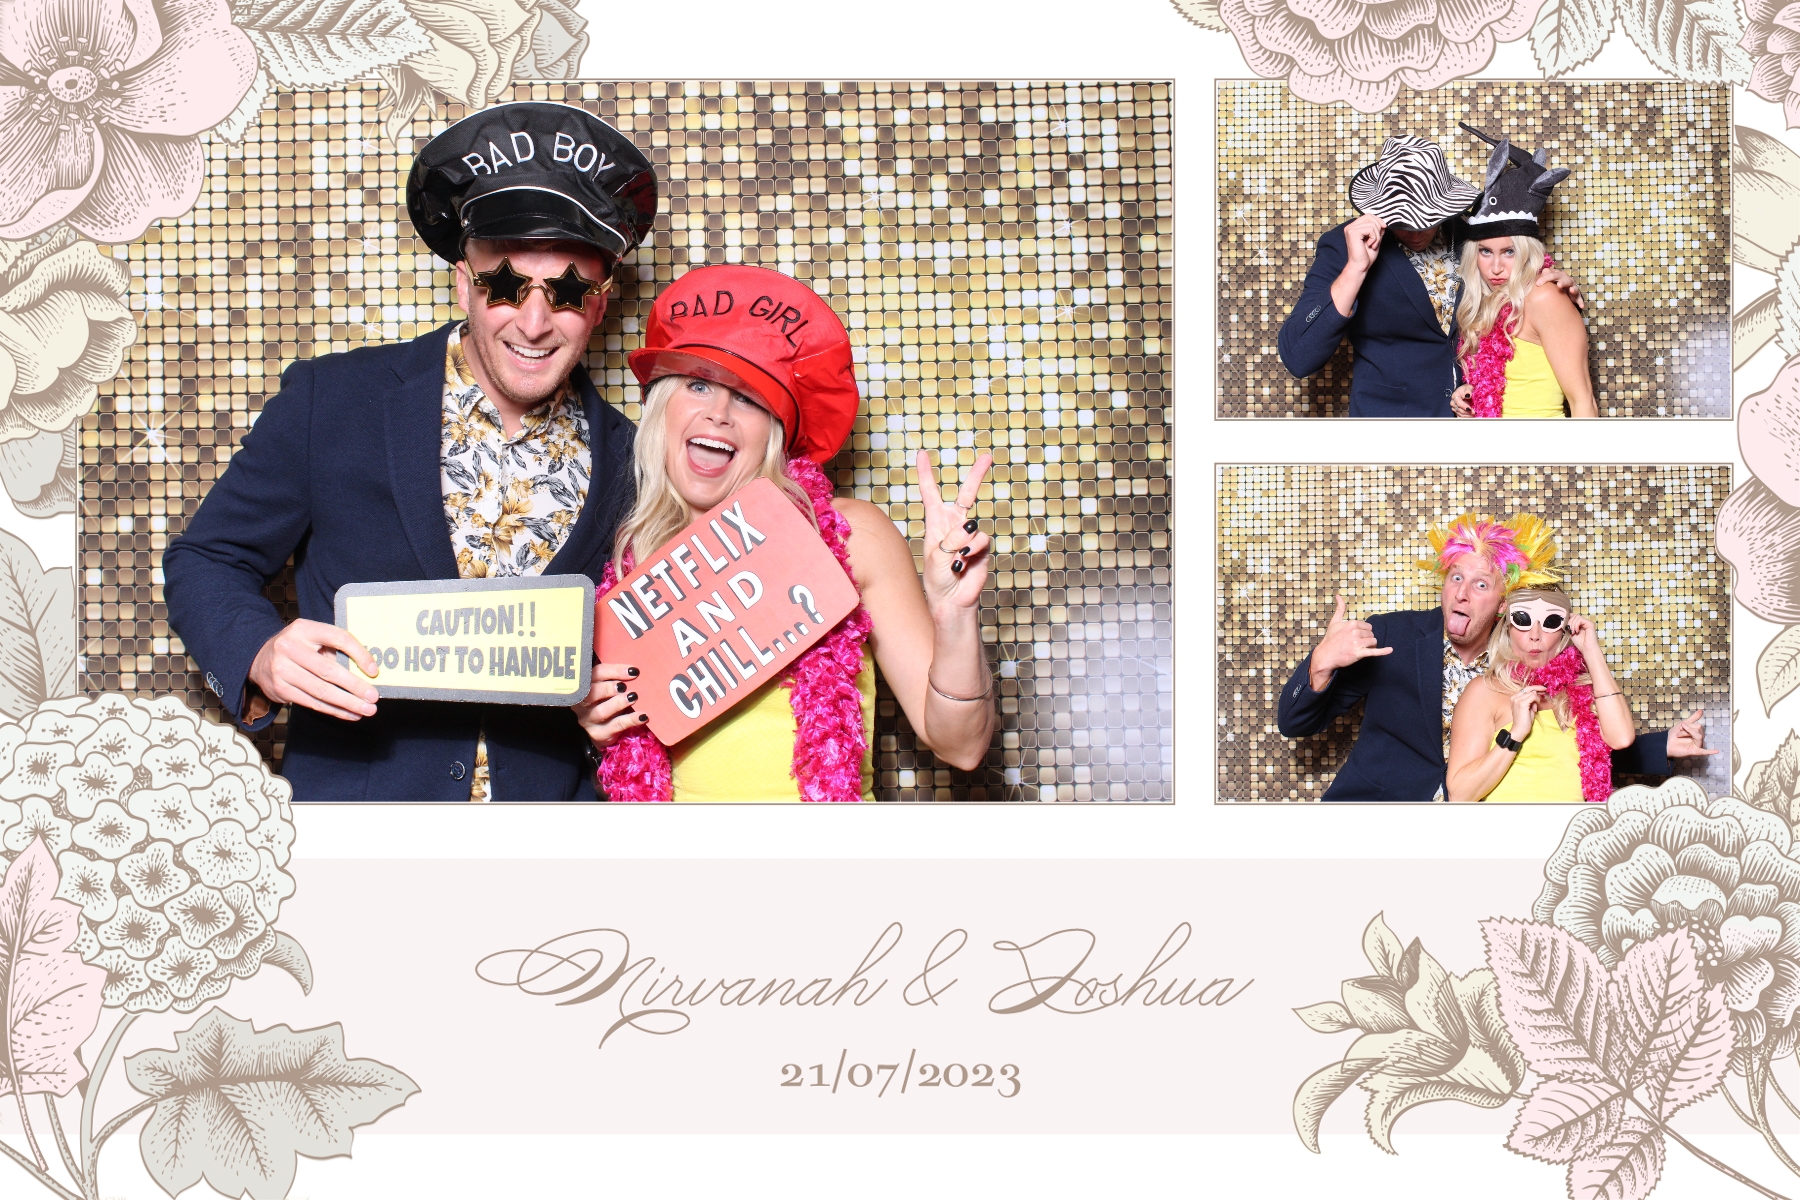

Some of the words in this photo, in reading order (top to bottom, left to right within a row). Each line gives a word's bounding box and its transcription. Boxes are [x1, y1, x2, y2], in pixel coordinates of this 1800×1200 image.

[553, 131, 616, 182] BOY
[749, 295, 809, 349] GIRL
[607, 500, 767, 640] NETFLIX
[415, 601, 536, 638] CAUTION!!
[671, 570, 764, 659] AND
[363, 646, 399, 670] OO
[404, 646, 450, 673] HOT
[454, 646, 484, 675] TO
[489, 646, 576, 680] HANDLE
[669, 584, 825, 719] CHILL...?
